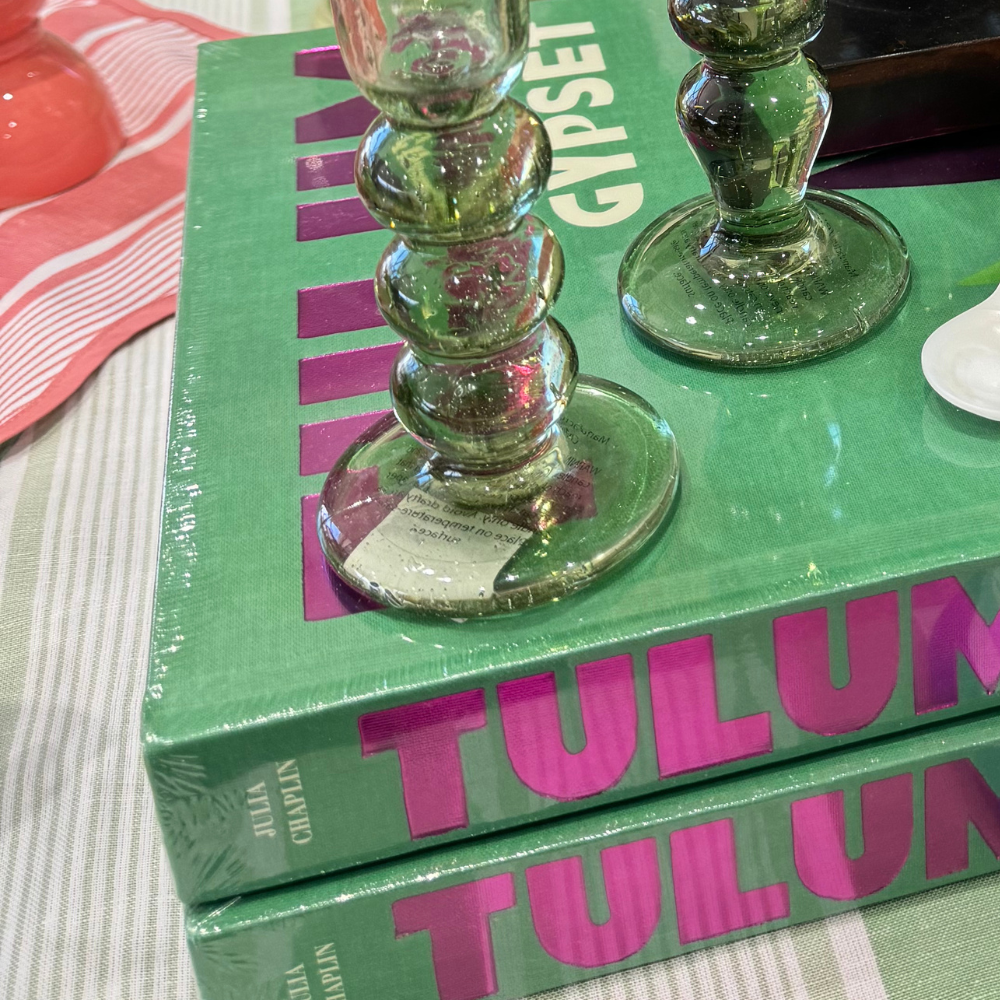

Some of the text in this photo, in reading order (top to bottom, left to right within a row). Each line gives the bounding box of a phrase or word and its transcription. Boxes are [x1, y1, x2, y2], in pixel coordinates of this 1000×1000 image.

[522, 21, 645, 228] GYPSET
[247, 780, 277, 838] JULIA
[275, 758, 313, 845] CHAPLIN
